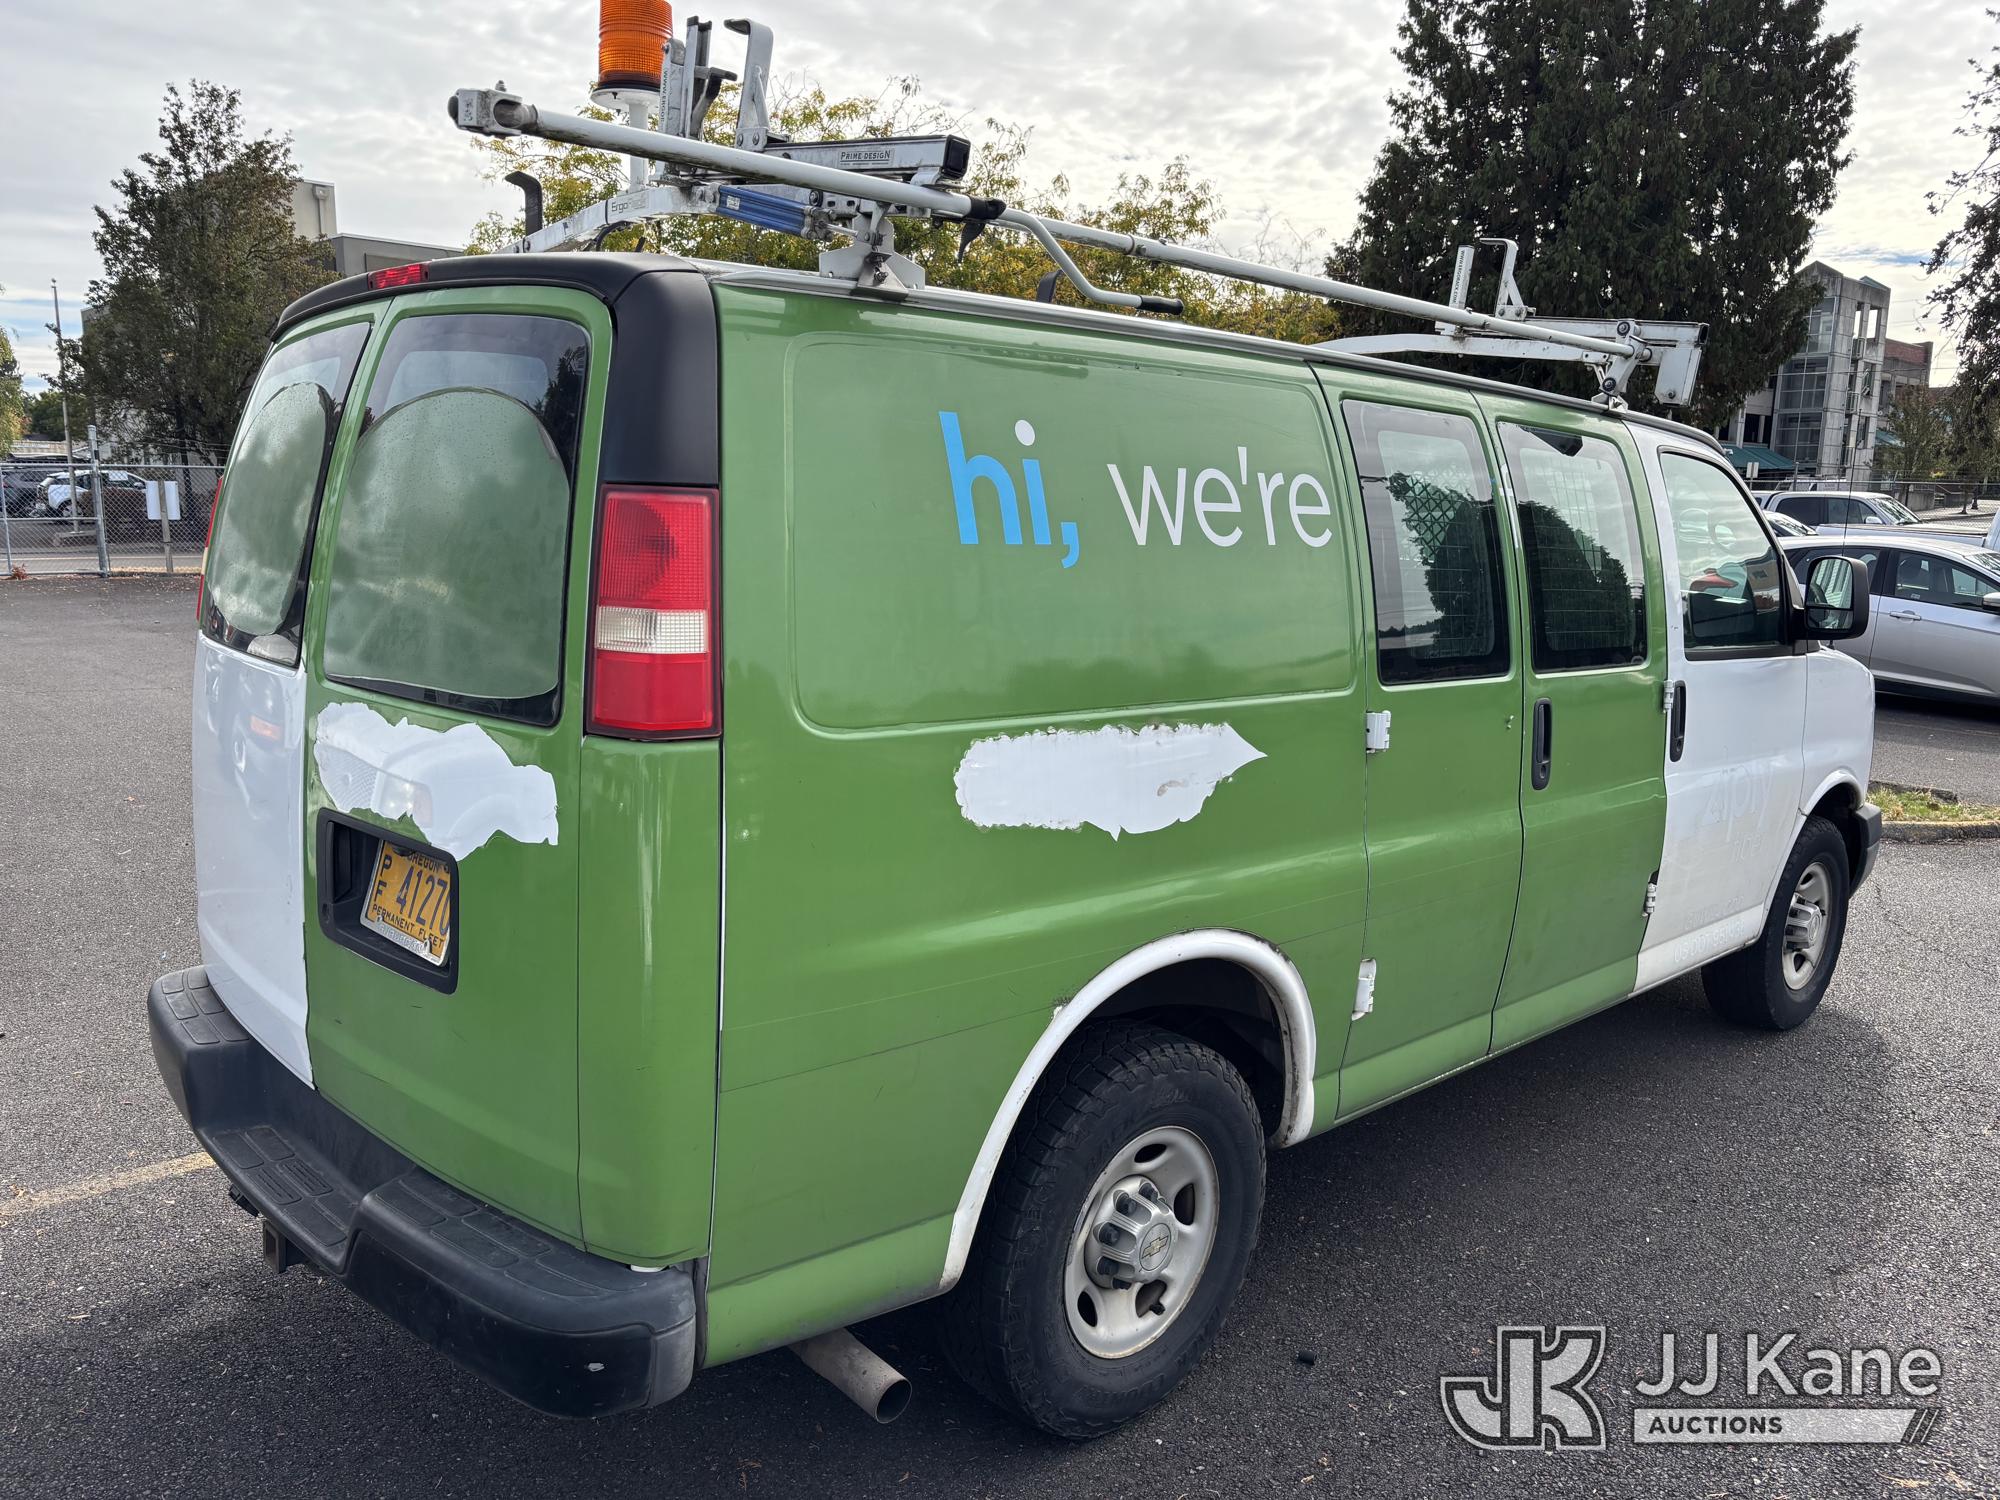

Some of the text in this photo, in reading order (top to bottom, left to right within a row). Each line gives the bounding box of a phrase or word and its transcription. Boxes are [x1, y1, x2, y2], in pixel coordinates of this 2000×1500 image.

[840, 151, 862, 161] PRIME
[938, 411, 1333, 569] hi, we're
[372, 904, 416, 934] PERMANENT
[418, 928, 446, 949] FLEET
